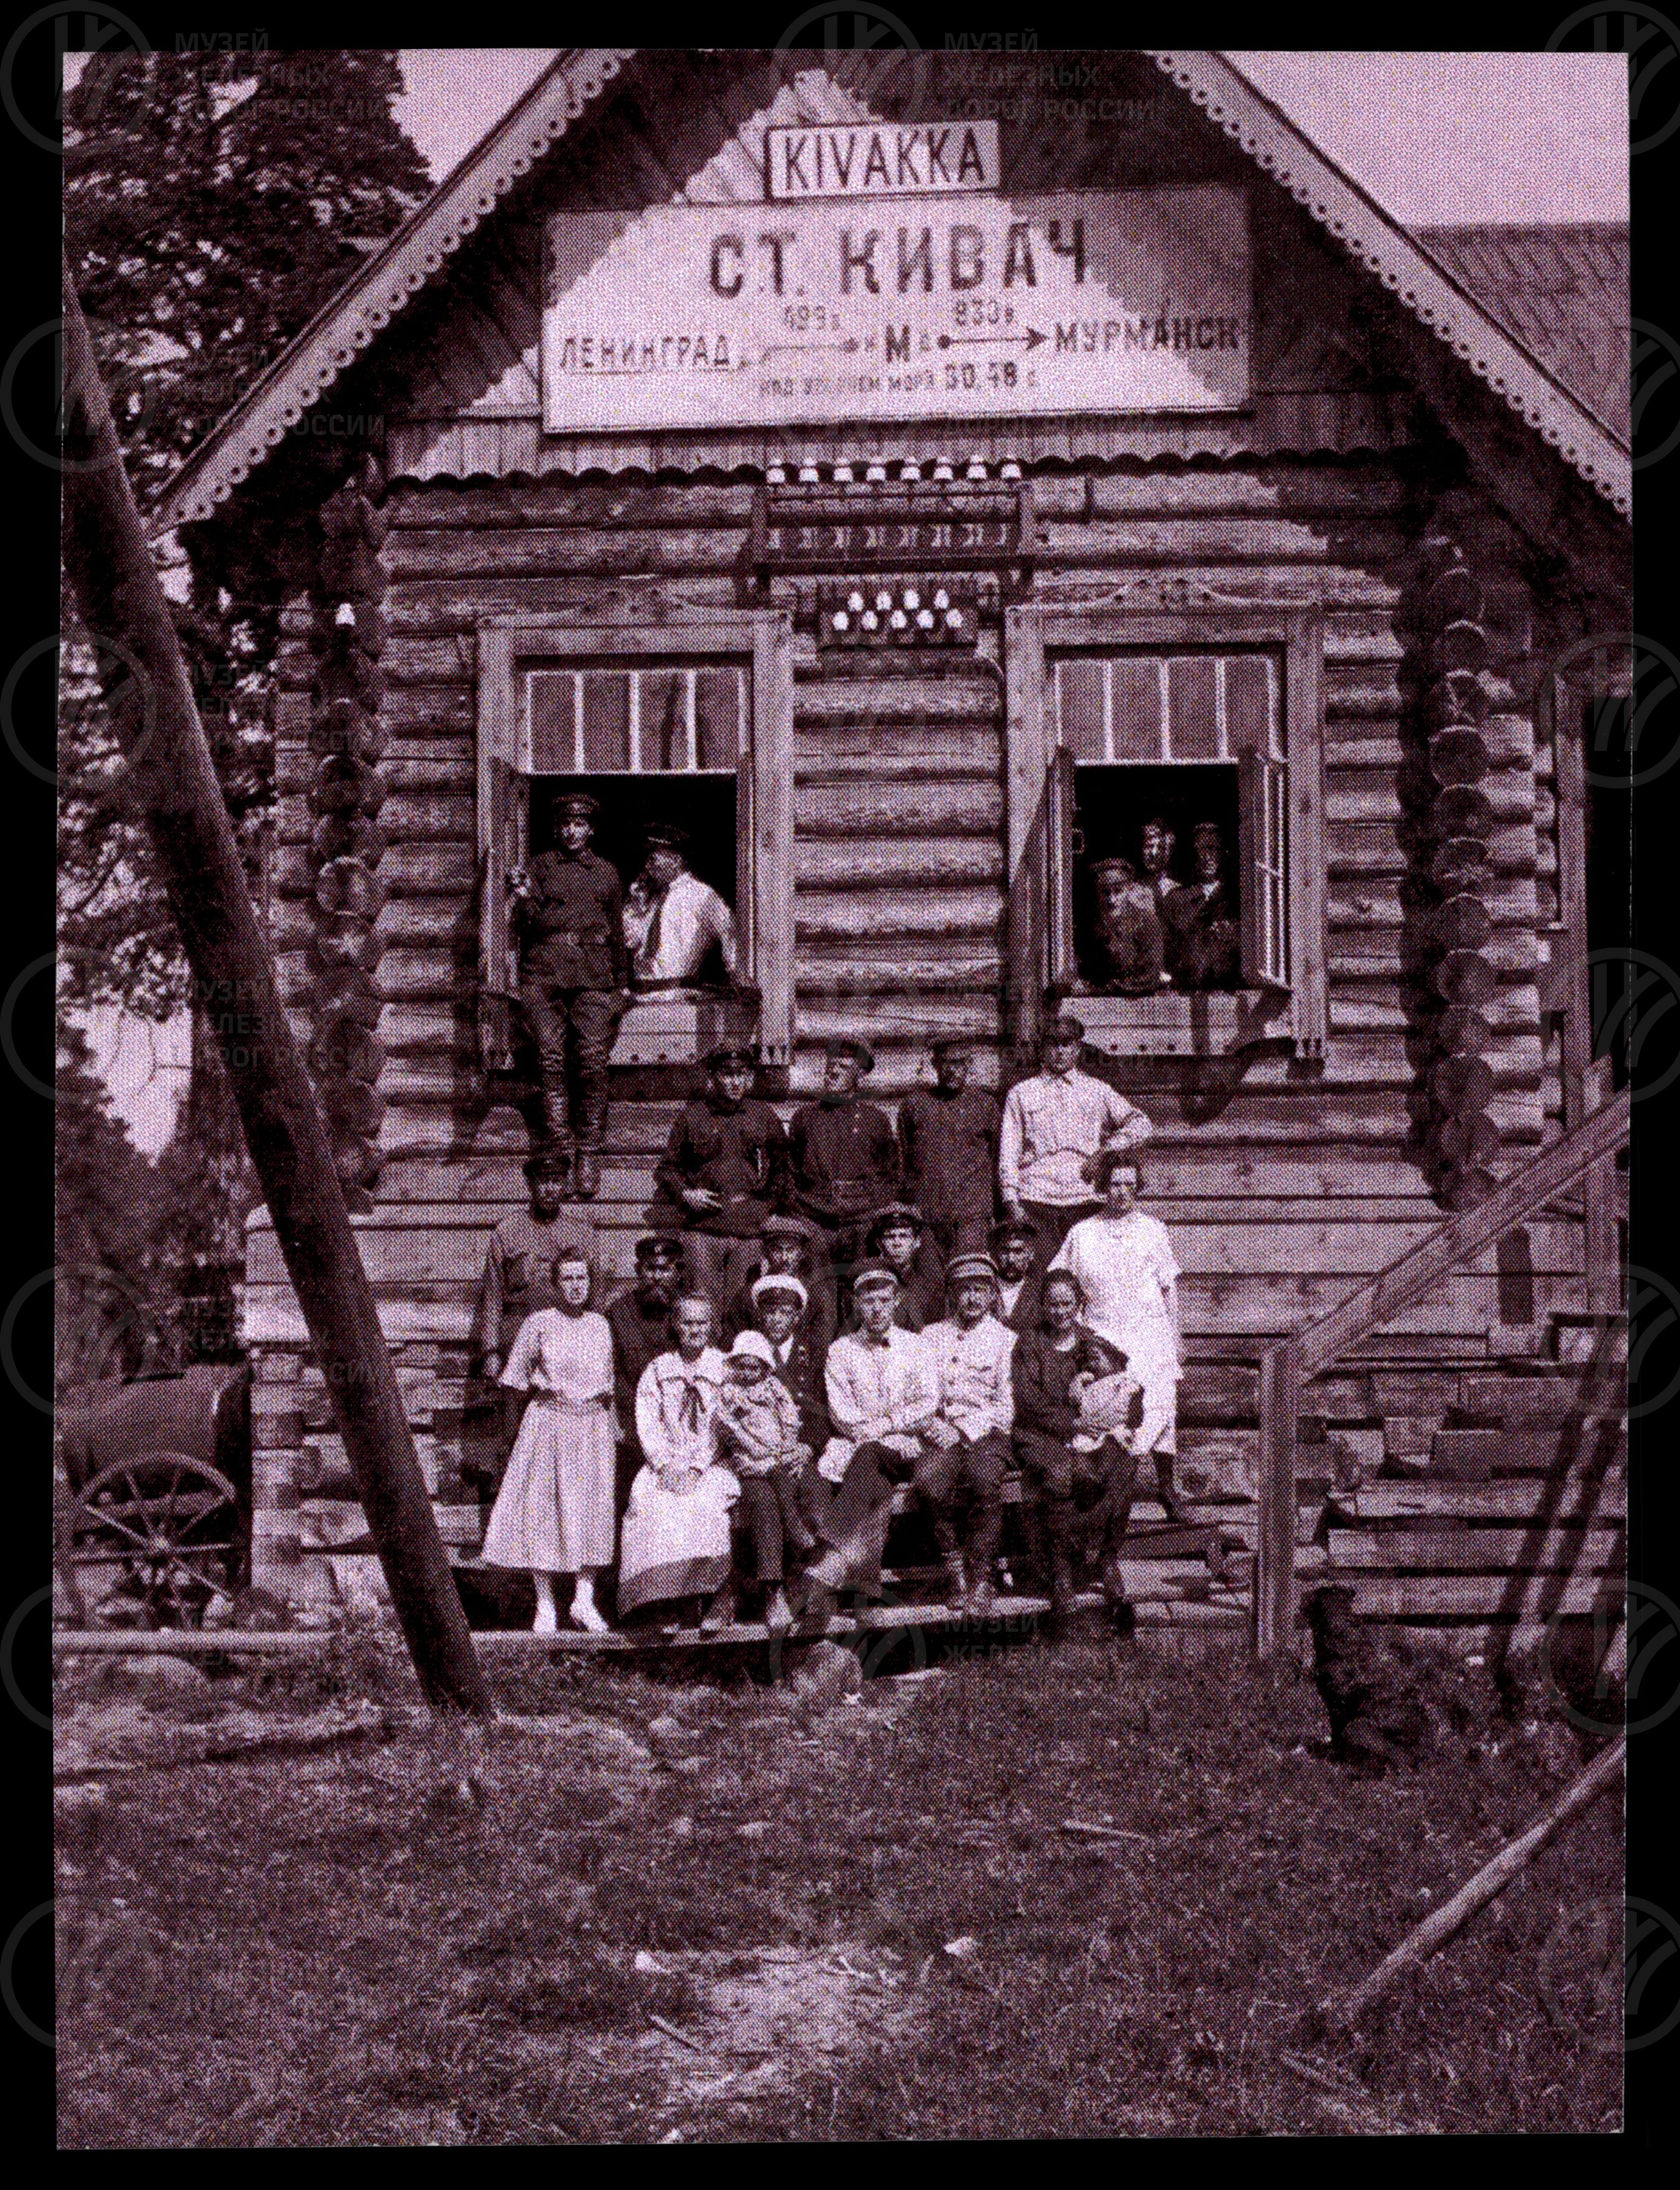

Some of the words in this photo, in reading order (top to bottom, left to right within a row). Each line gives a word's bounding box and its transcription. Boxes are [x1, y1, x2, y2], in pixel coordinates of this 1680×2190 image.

[784, 128, 985, 190] KIVAKKA
[709, 231, 805, 298] СТ.
[841, 218, 1087, 295] КИВАЧ
[559, 333, 731, 369] ЛЕНИНГРАД
[1055, 317, 1240, 354] МУРМАНСК
